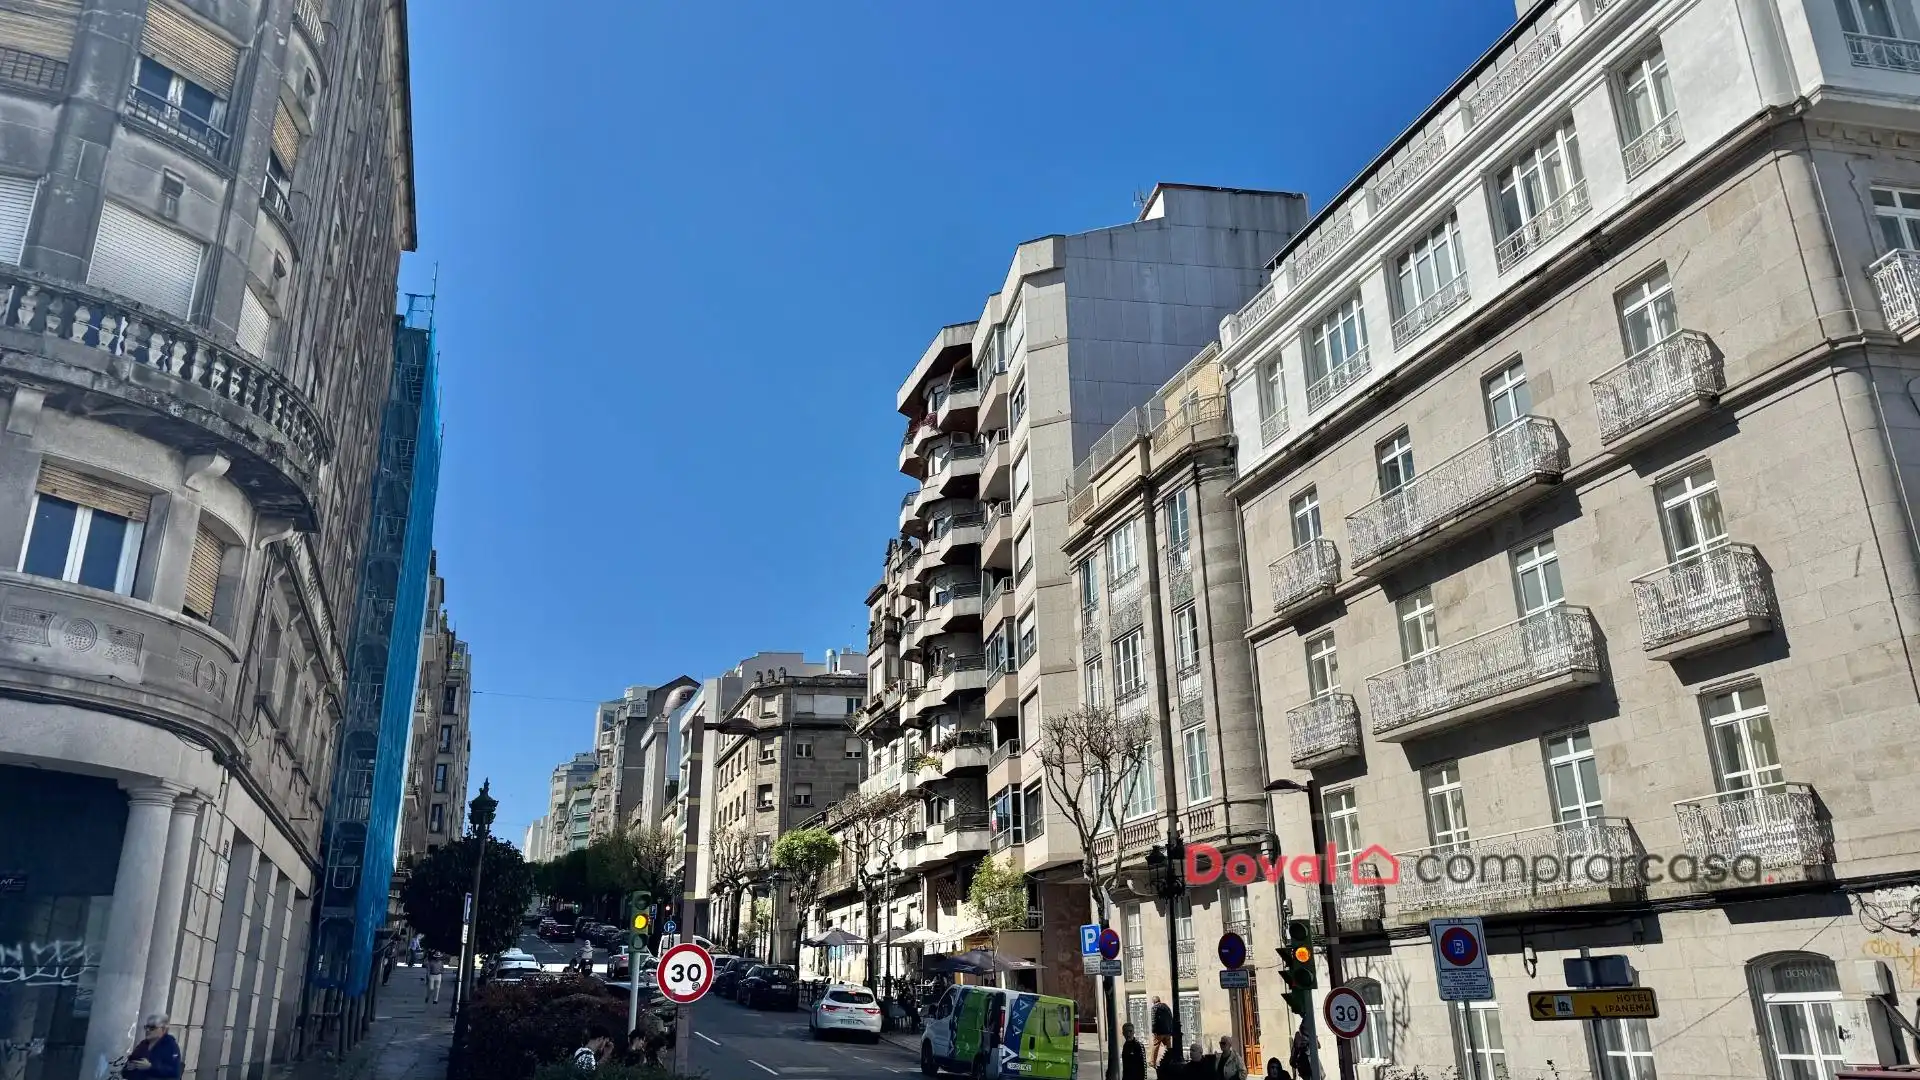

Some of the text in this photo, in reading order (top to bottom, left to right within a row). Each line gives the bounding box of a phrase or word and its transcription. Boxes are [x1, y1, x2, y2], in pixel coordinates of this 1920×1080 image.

[1084, 928, 1097, 952] P
[671, 963, 702, 983] 30
[1616, 993, 1651, 1004] HOTEL
[1335, 1005, 1359, 1022] 30
[1605, 1003, 1652, 1014] IPANEMA
